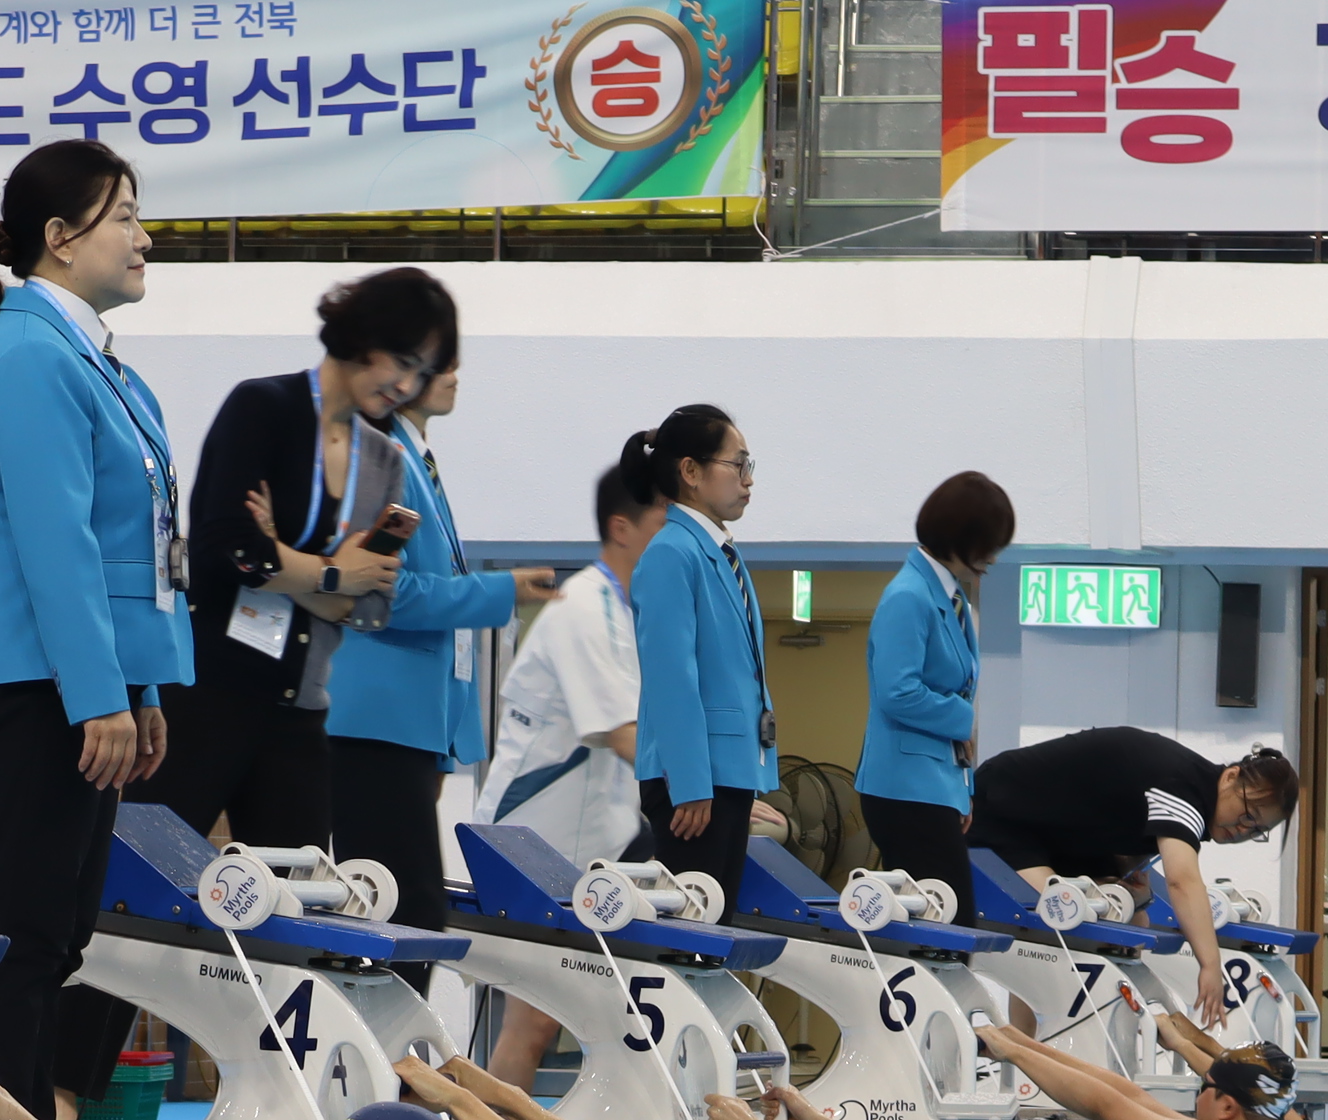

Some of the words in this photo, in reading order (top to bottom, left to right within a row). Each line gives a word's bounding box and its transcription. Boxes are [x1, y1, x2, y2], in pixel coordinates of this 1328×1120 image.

[72, 6, 136, 43] 함께
[149, 5, 178, 42] 더
[191, 4, 222, 40] 큰
[234, 1, 298, 38] 전북
[49, 60, 212, 146] 수영
[232, 48, 488, 141] 선수단
[590, 39, 663, 119] 승
[981, 5, 1240, 165] 필승
[223, 876, 256, 914] Myrtha
[232, 893, 259, 922] Pools
[594, 887, 621, 918] Myrtha
[602, 900, 623, 925] Pools
[857, 891, 882, 920] Myrtha
[1051, 895, 1065, 923] Myrtha
[864, 904, 884, 925] Pools
[561, 957, 614, 978] BUMWOO
[1017, 948, 1058, 963] BUMWOO
[879, 965, 917, 1032] 6
[1067, 962, 1106, 1018] 7
[1223, 958, 1251, 1009] 8
[259, 979, 318, 1071] 4
[623, 976, 665, 1052] 5
[869, 1099, 916, 1114] Myrtha
